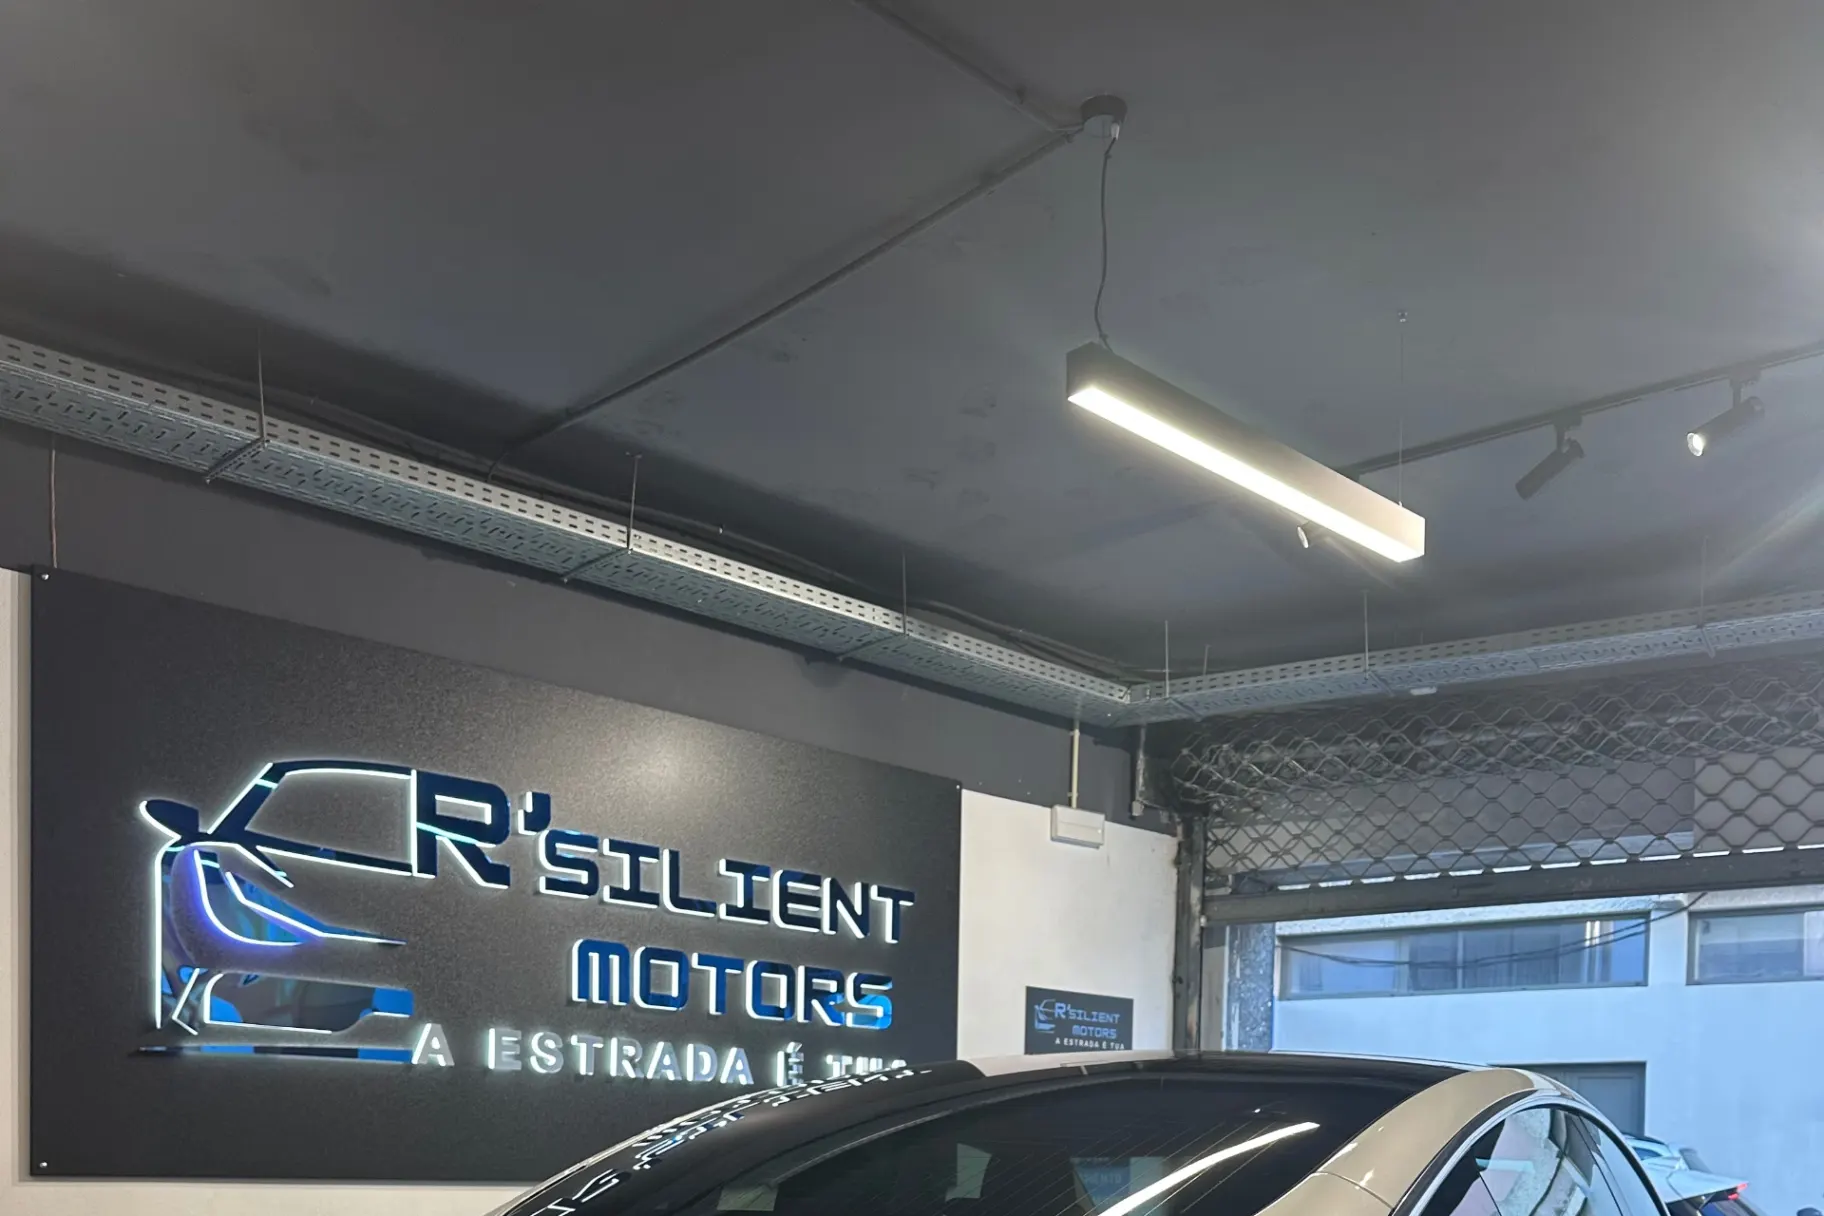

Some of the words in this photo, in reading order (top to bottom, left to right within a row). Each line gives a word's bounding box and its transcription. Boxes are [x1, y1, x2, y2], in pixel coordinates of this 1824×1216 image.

[571, 939, 893, 1031] MOTORS
[1055, 1037, 1061, 1045] A
[1063, 1038, 1099, 1048] ESTRADA
[1110, 1042, 1125, 1050] TUA
[1071, 1024, 1117, 1040] MOTORS
[411, 1022, 455, 1067] A
[487, 1027, 755, 1086] ESTRADA
